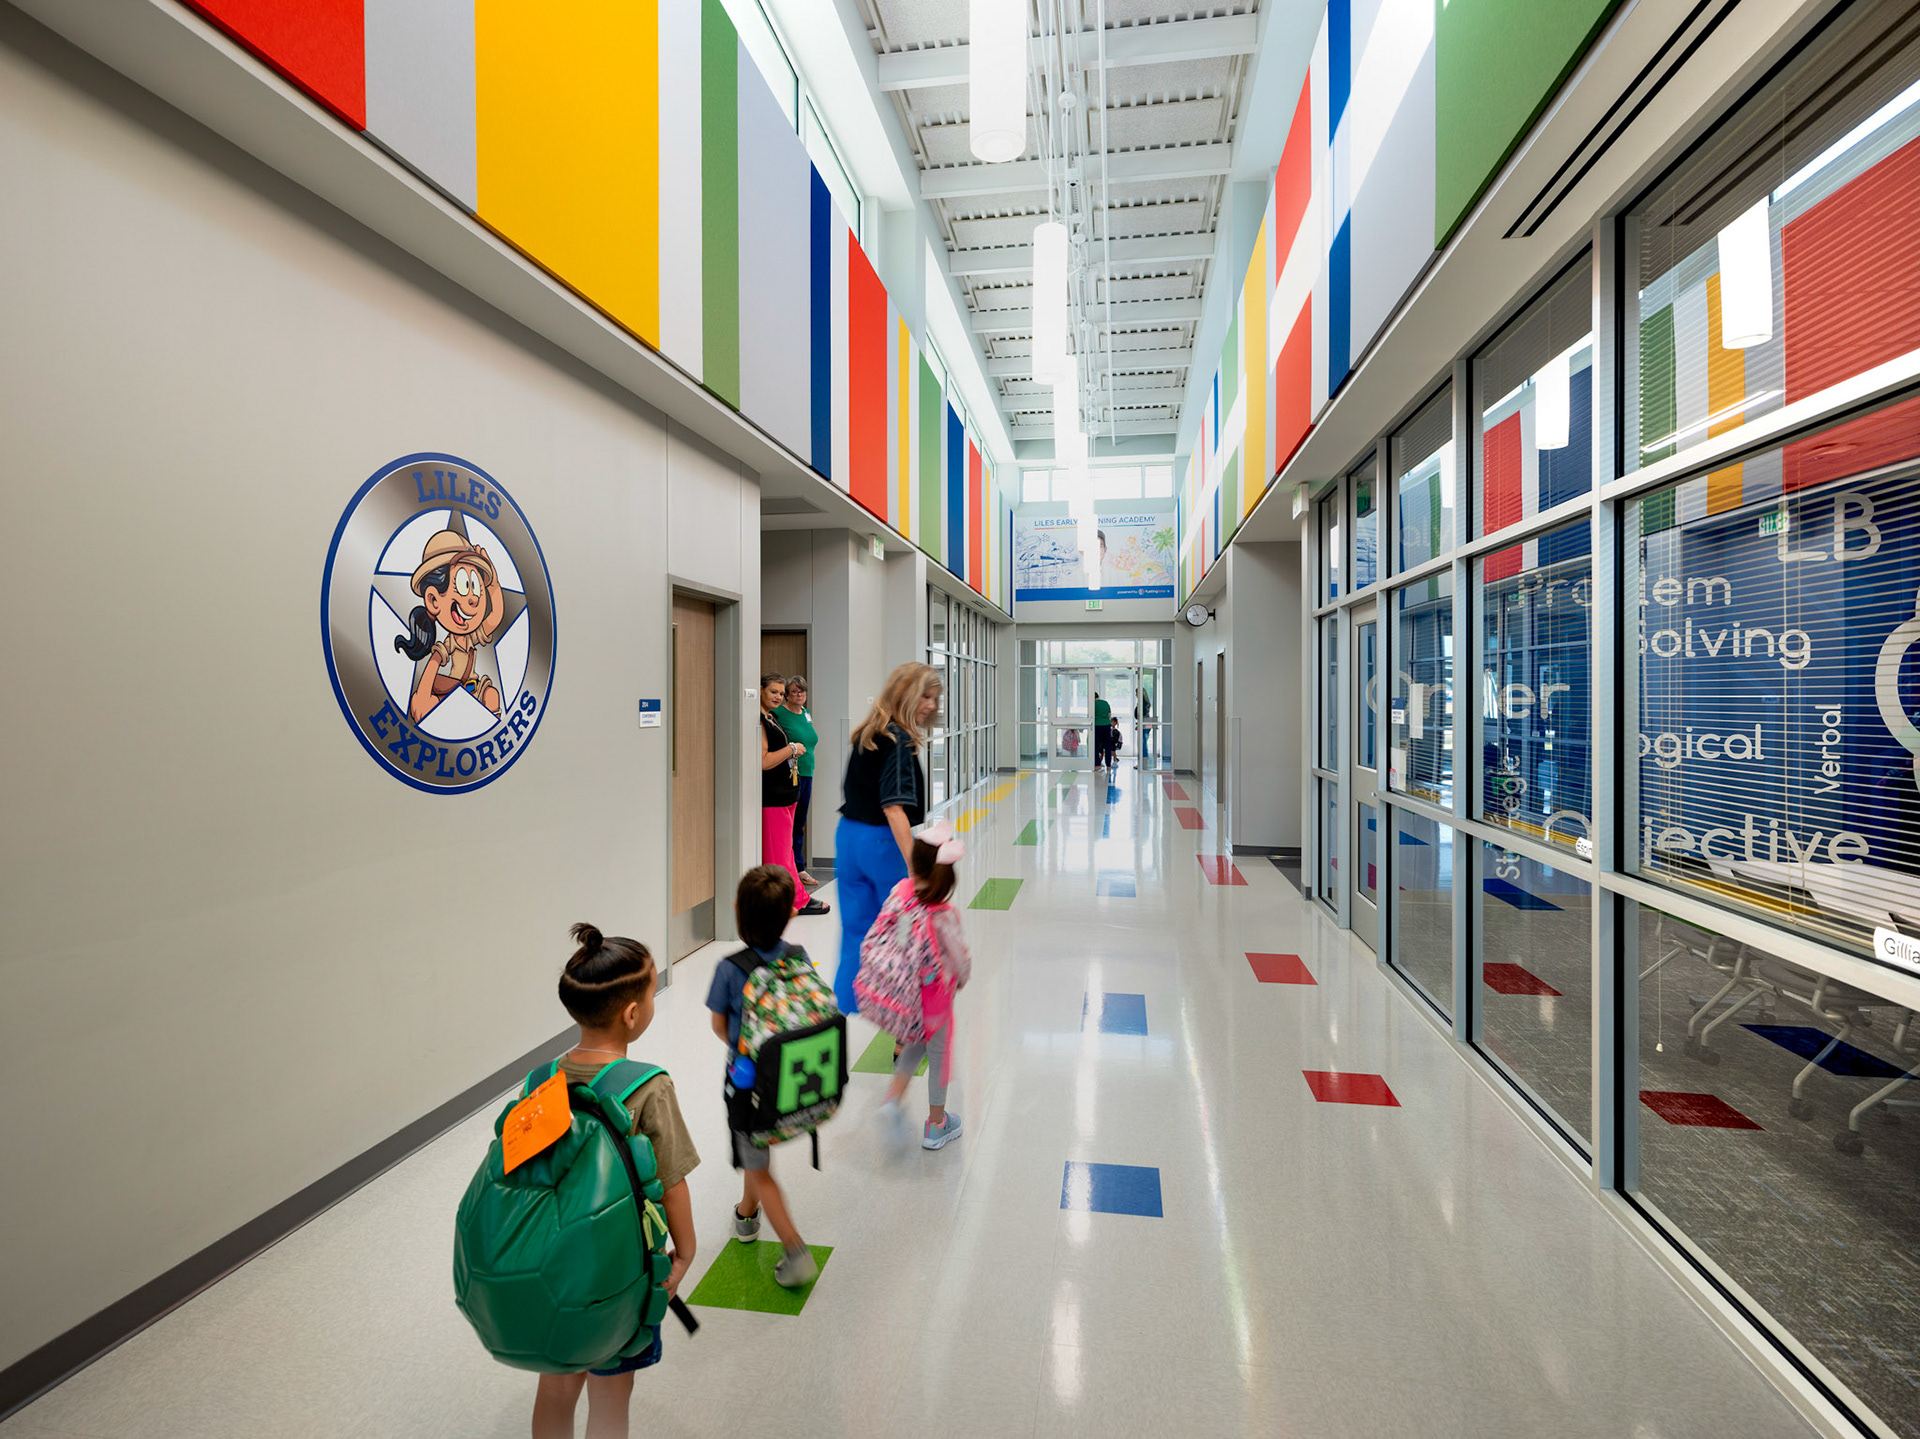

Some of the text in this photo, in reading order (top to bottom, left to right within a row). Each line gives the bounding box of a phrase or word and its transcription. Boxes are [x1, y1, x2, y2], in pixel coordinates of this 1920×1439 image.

[412, 470, 502, 520] LILES
[1034, 519, 1055, 527] LILES
[1056, 518, 1078, 526] EARLY
[1118, 515, 1156, 523] ACADEMY
[1088, 600, 1101, 609] EXIT
[368, 690, 537, 778] EXPLORERS
[1639, 723, 1765, 769] ogical
[1813, 703, 1842, 794] Verbal
